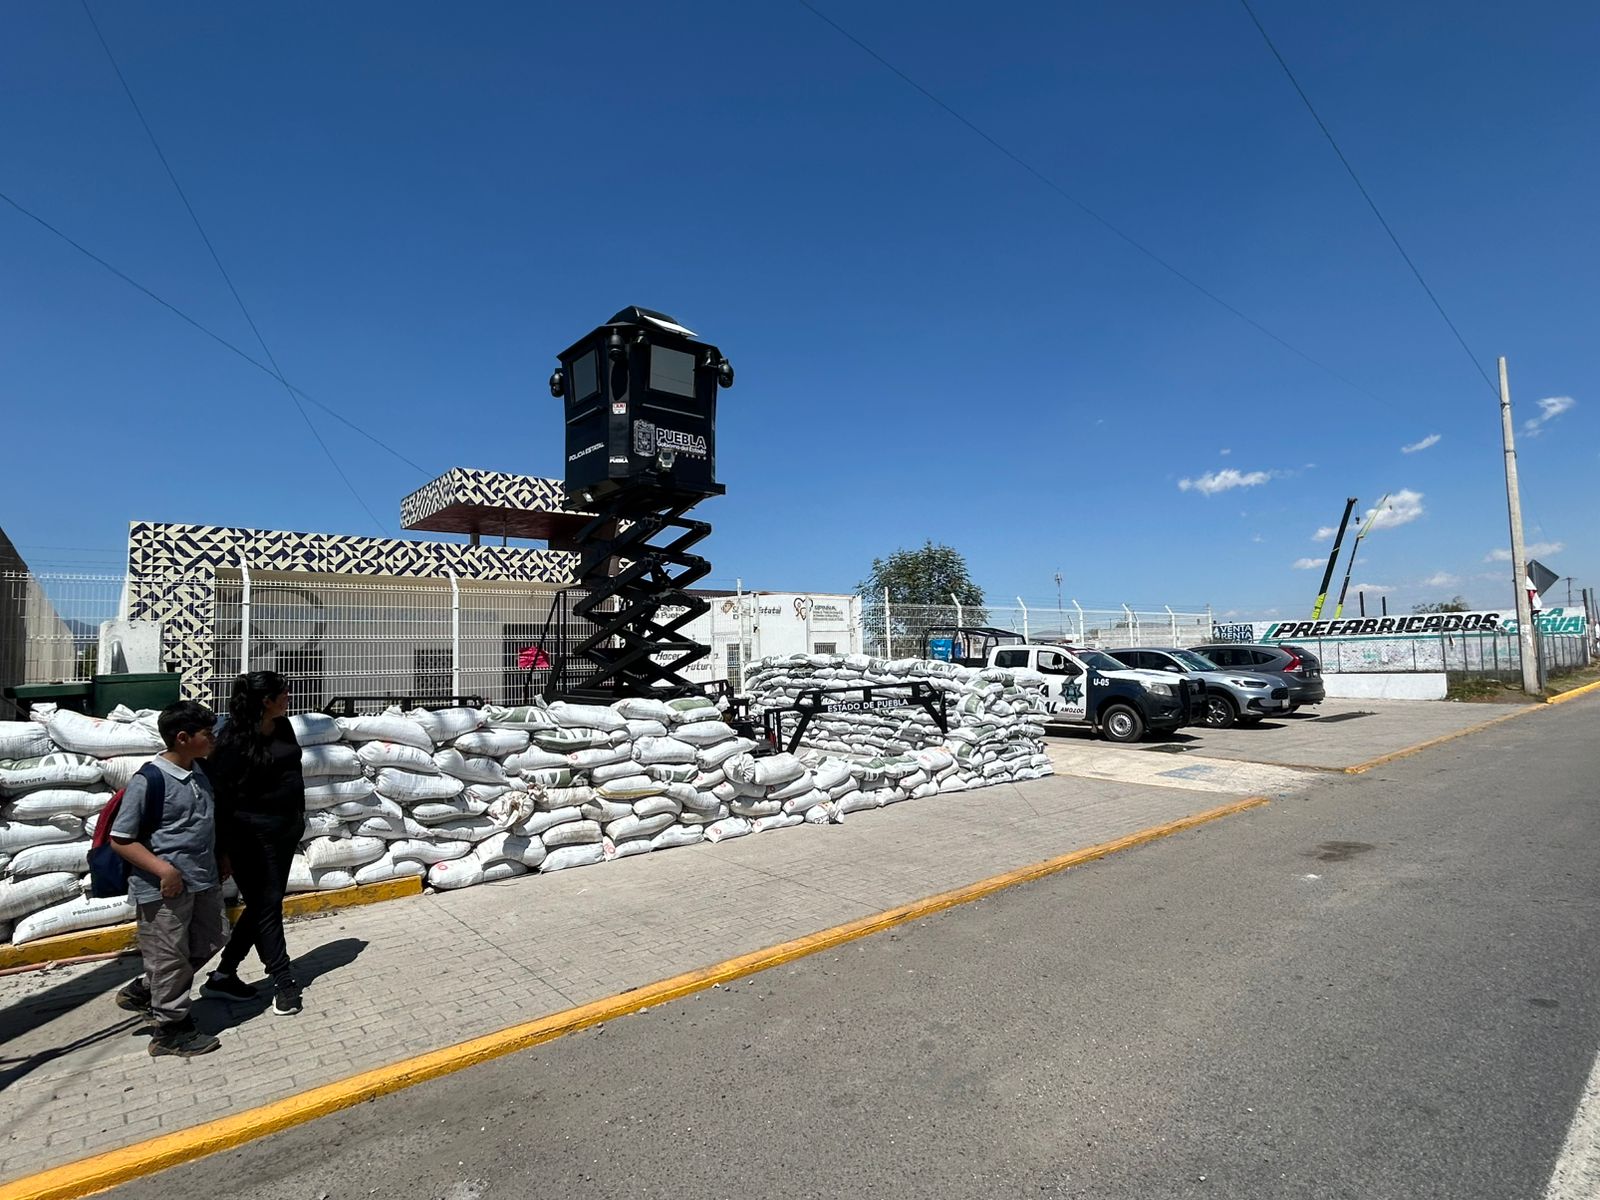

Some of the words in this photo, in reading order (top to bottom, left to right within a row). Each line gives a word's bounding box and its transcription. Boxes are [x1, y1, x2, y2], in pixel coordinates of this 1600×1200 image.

[656, 427, 707, 450] PUEBLA
[1220, 624, 1252, 633] VENTA
[1271, 613, 1500, 638] PREFABRICADOS
[1502, 616, 1581, 634] CRVA
[1221, 632, 1252, 640] RENTA
[1093, 678, 1110, 686] U-05
[827, 703, 861, 713] ESTADO
[863, 701, 874, 710] DE
[877, 698, 909, 709] PUEBLA
[9, 776, 47, 786] GRATUITA
[72, 904, 111, 916] PROHIBIDA
